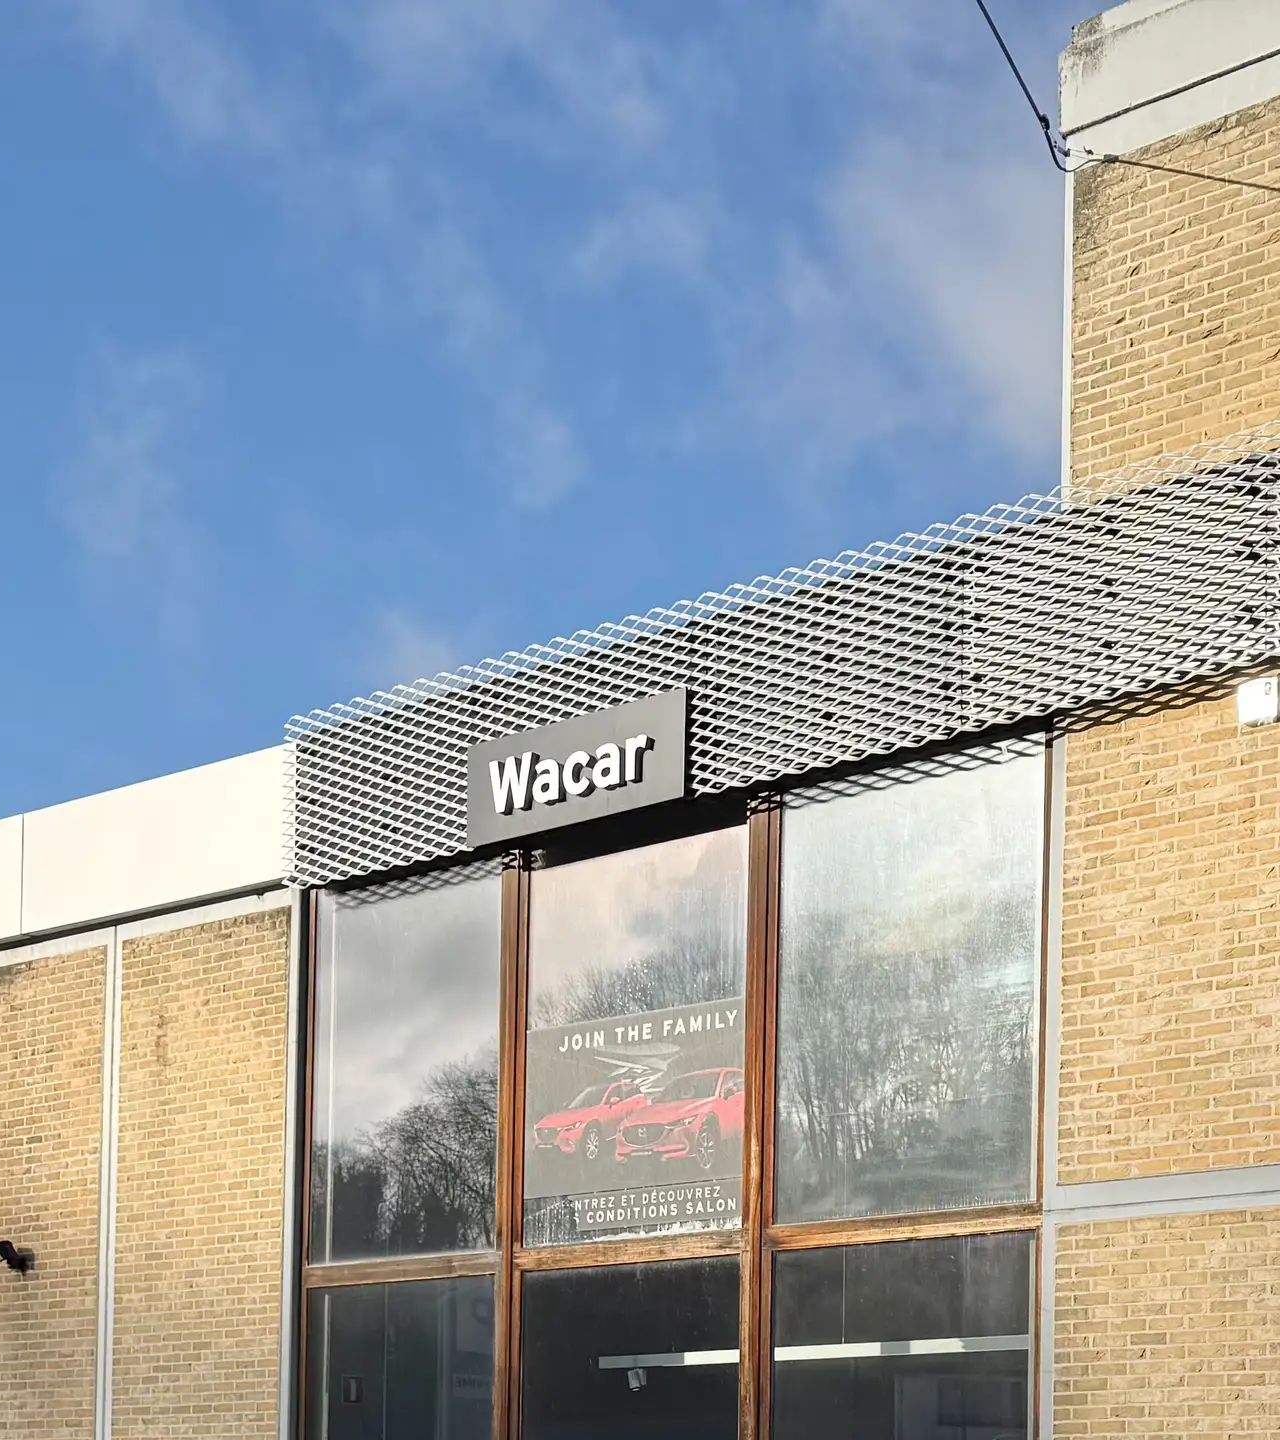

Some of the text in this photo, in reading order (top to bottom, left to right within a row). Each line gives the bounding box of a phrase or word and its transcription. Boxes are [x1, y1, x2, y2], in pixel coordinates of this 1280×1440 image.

[488, 733, 655, 816] Wacar
[559, 1009, 738, 1053] JOIN THE FAMILY
[574, 1186, 721, 1211] NTREZ ET DÉCOUVREZ
[586, 1203, 678, 1224] CONDITIONS
[685, 1197, 737, 1215] SALON
